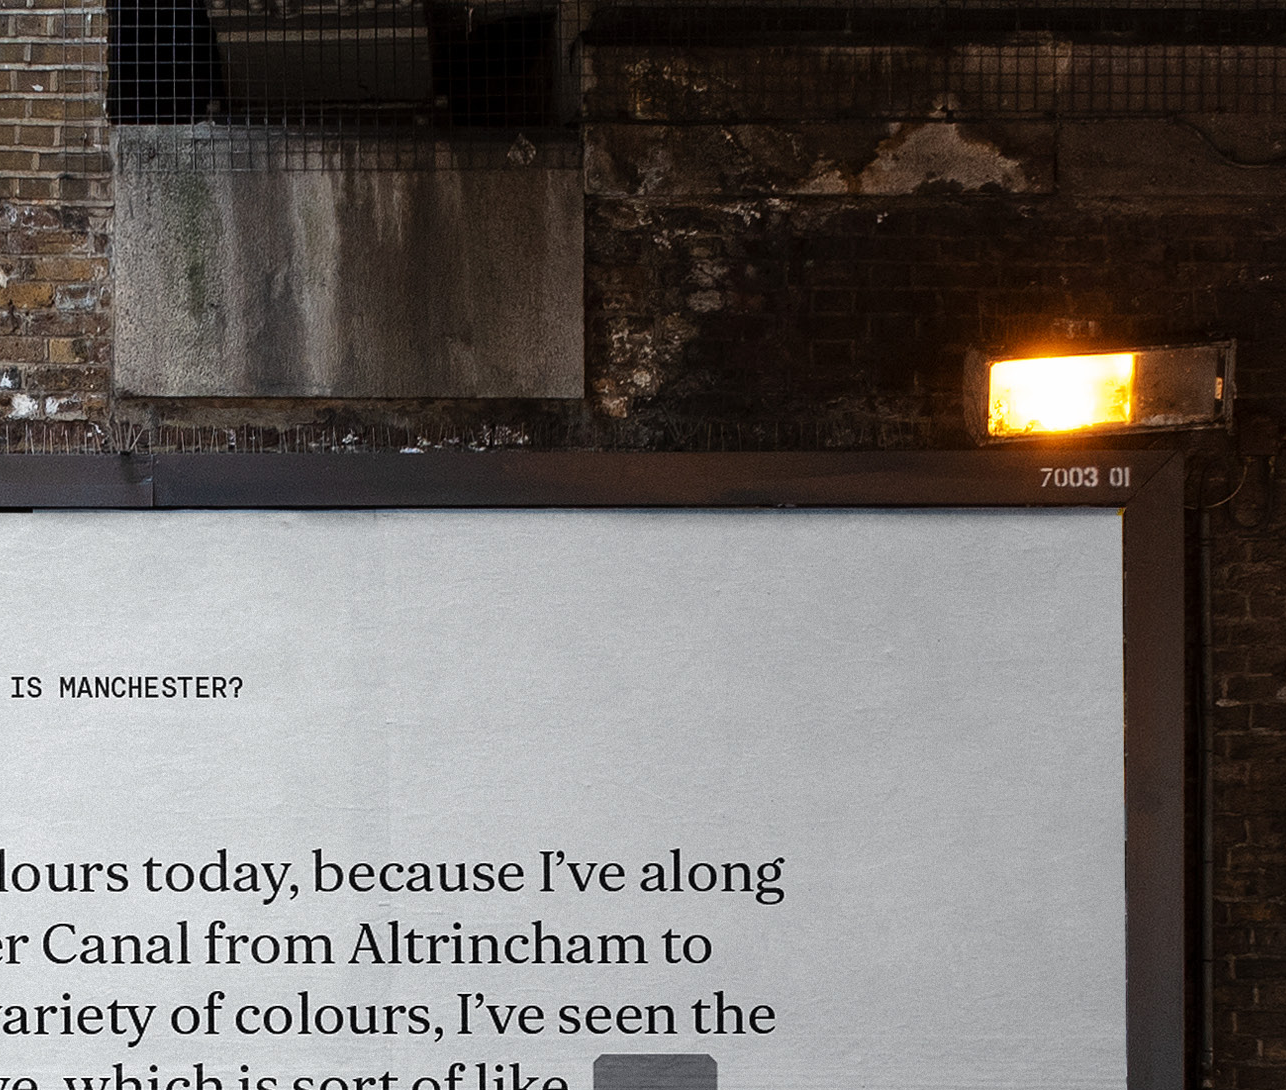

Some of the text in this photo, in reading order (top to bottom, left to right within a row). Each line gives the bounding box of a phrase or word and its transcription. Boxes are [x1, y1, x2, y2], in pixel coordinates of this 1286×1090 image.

[1040, 466, 1099, 488] 7003
[13, 678, 42, 698] IS
[61, 678, 243, 699] MANCHESTER?
[145, 850, 299, 905] today,
[314, 850, 524, 892] because
[542, 852, 626, 892] I’ve
[642, 850, 786, 905] along
[44, 922, 189, 965] Canal
[206, 922, 333, 964] from
[350, 922, 648, 964] Altrincham
[663, 931, 712, 964] to
[173, 992, 225, 1035] of
[237, 992, 444, 1043] colours,
[459, 994, 545, 1035] I’ve
[560, 1007, 678, 1035] seen
[693, 992, 776, 1035] the
